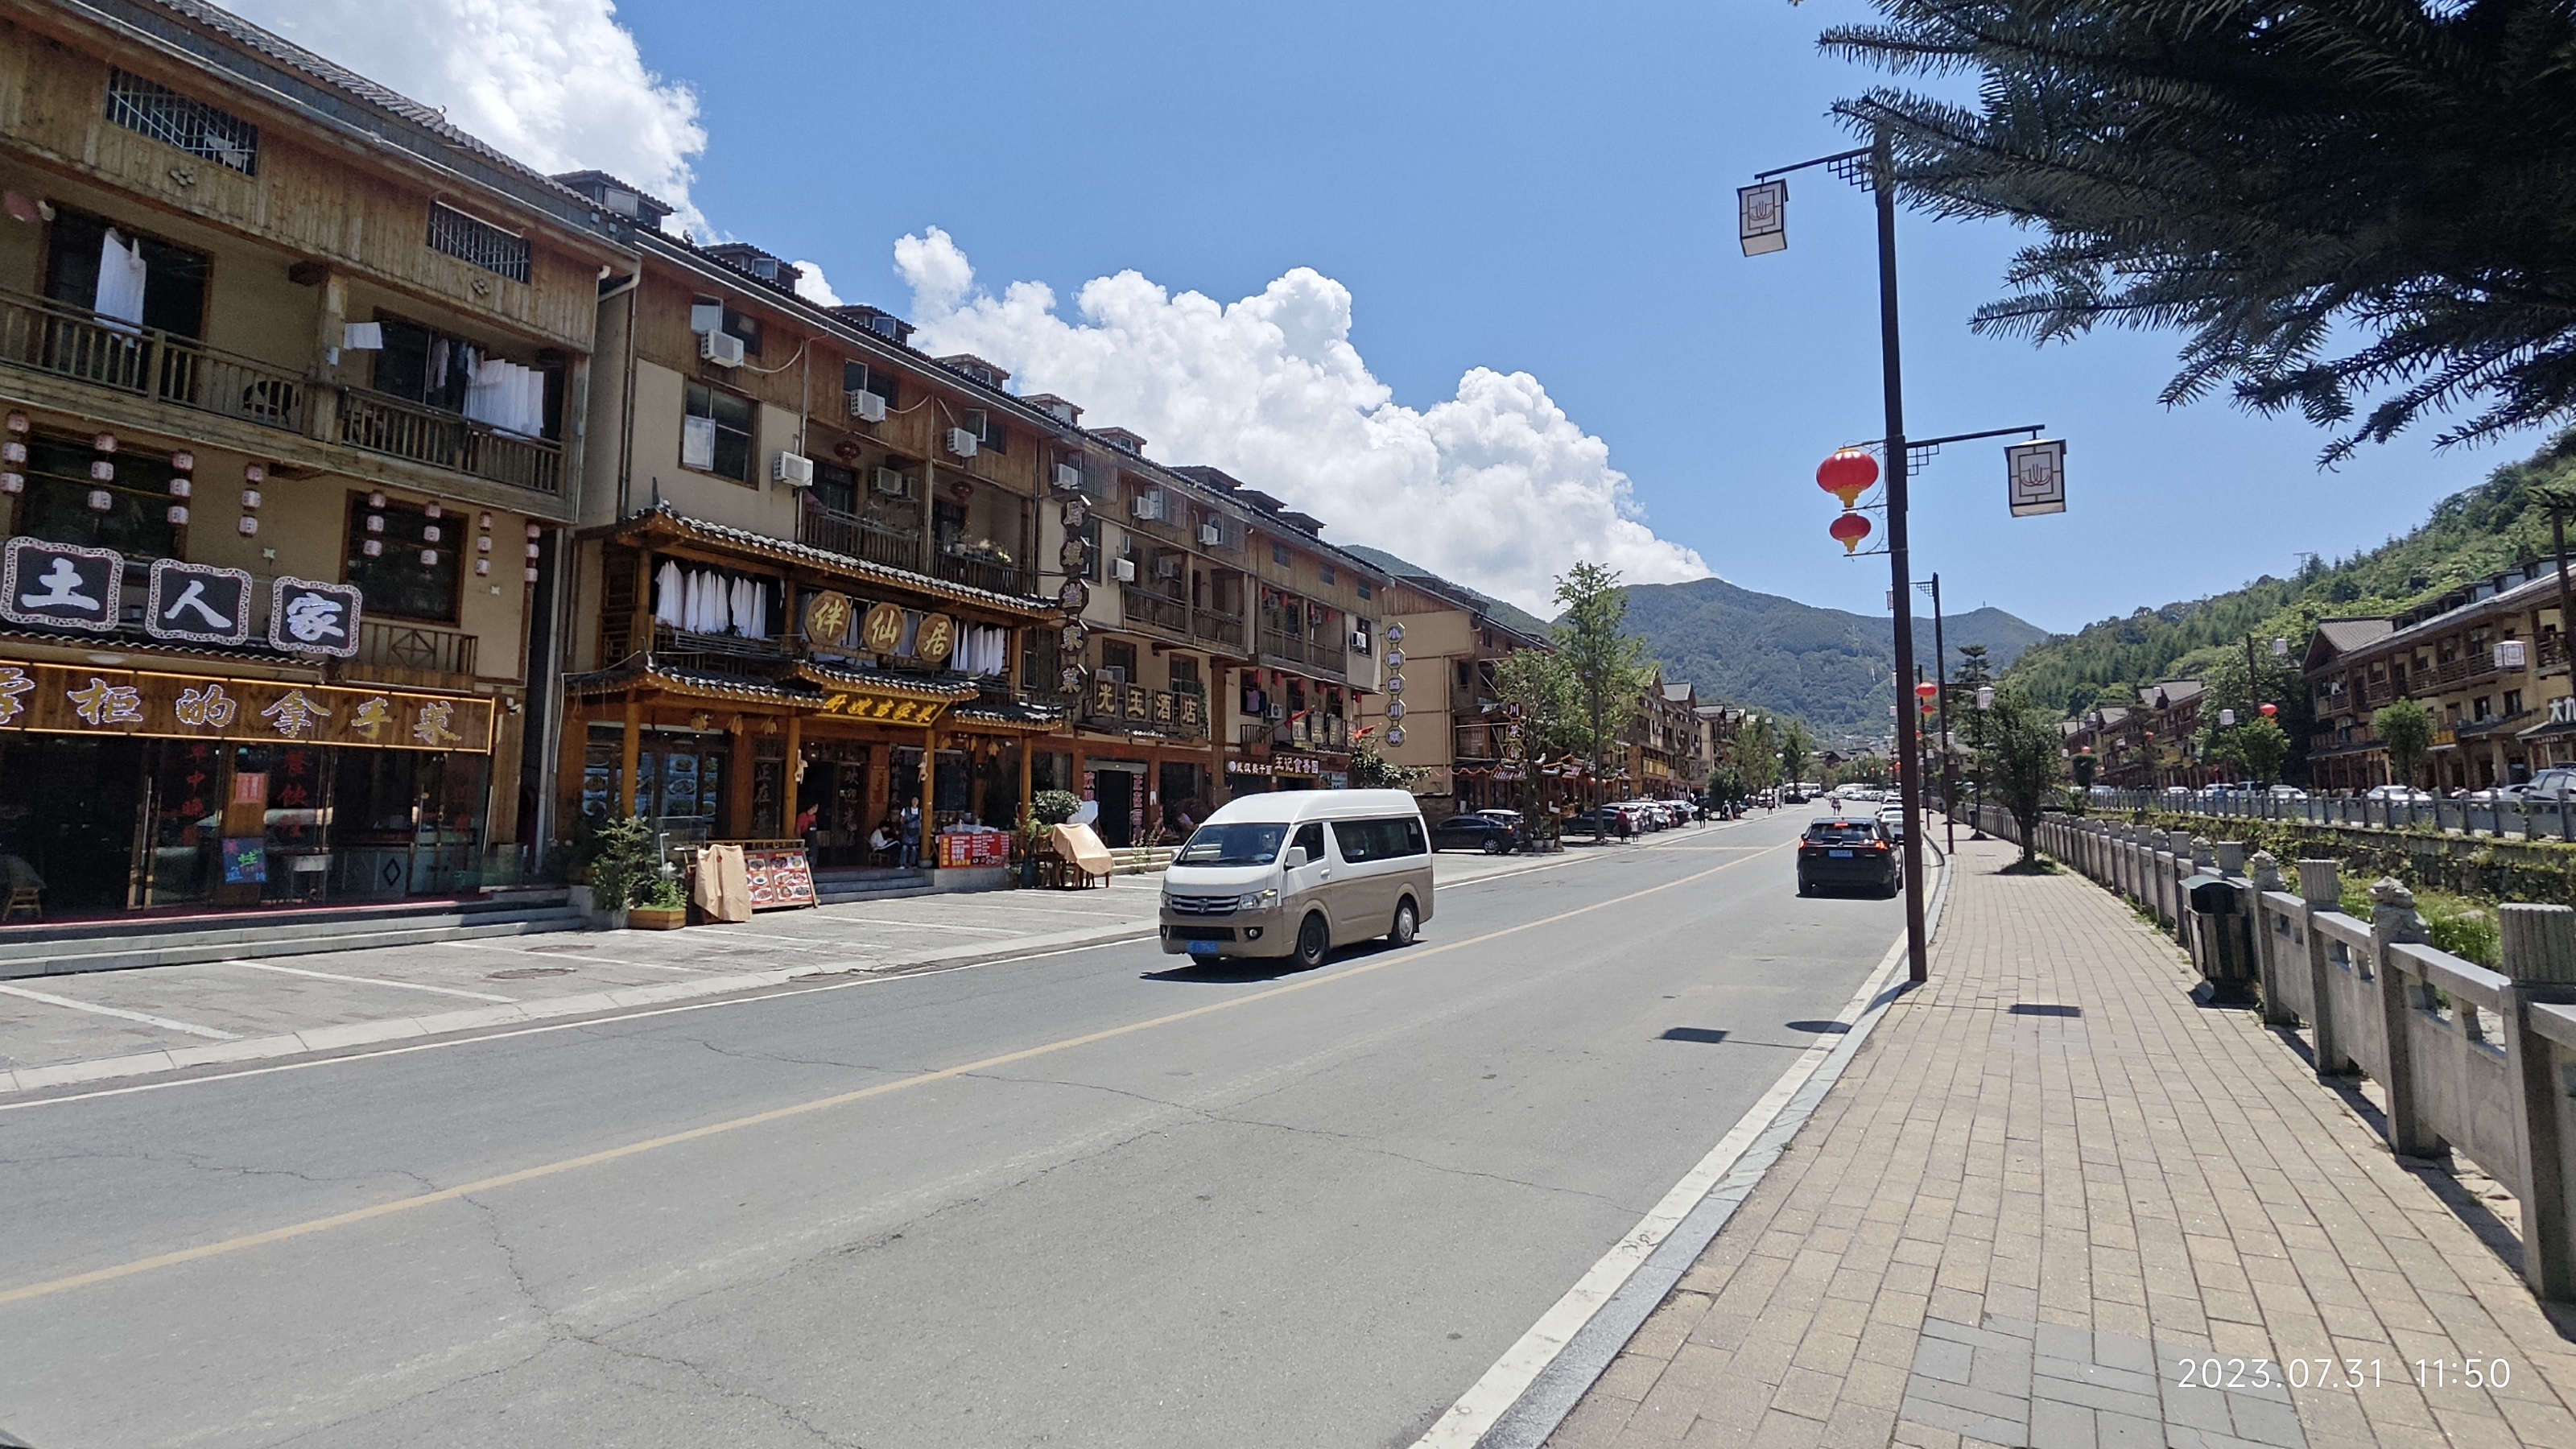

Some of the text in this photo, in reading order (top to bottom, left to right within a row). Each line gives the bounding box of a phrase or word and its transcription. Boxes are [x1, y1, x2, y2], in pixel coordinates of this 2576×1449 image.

[20, 557, 345, 642] 土人家
[814, 599, 948, 656] 伴仙居
